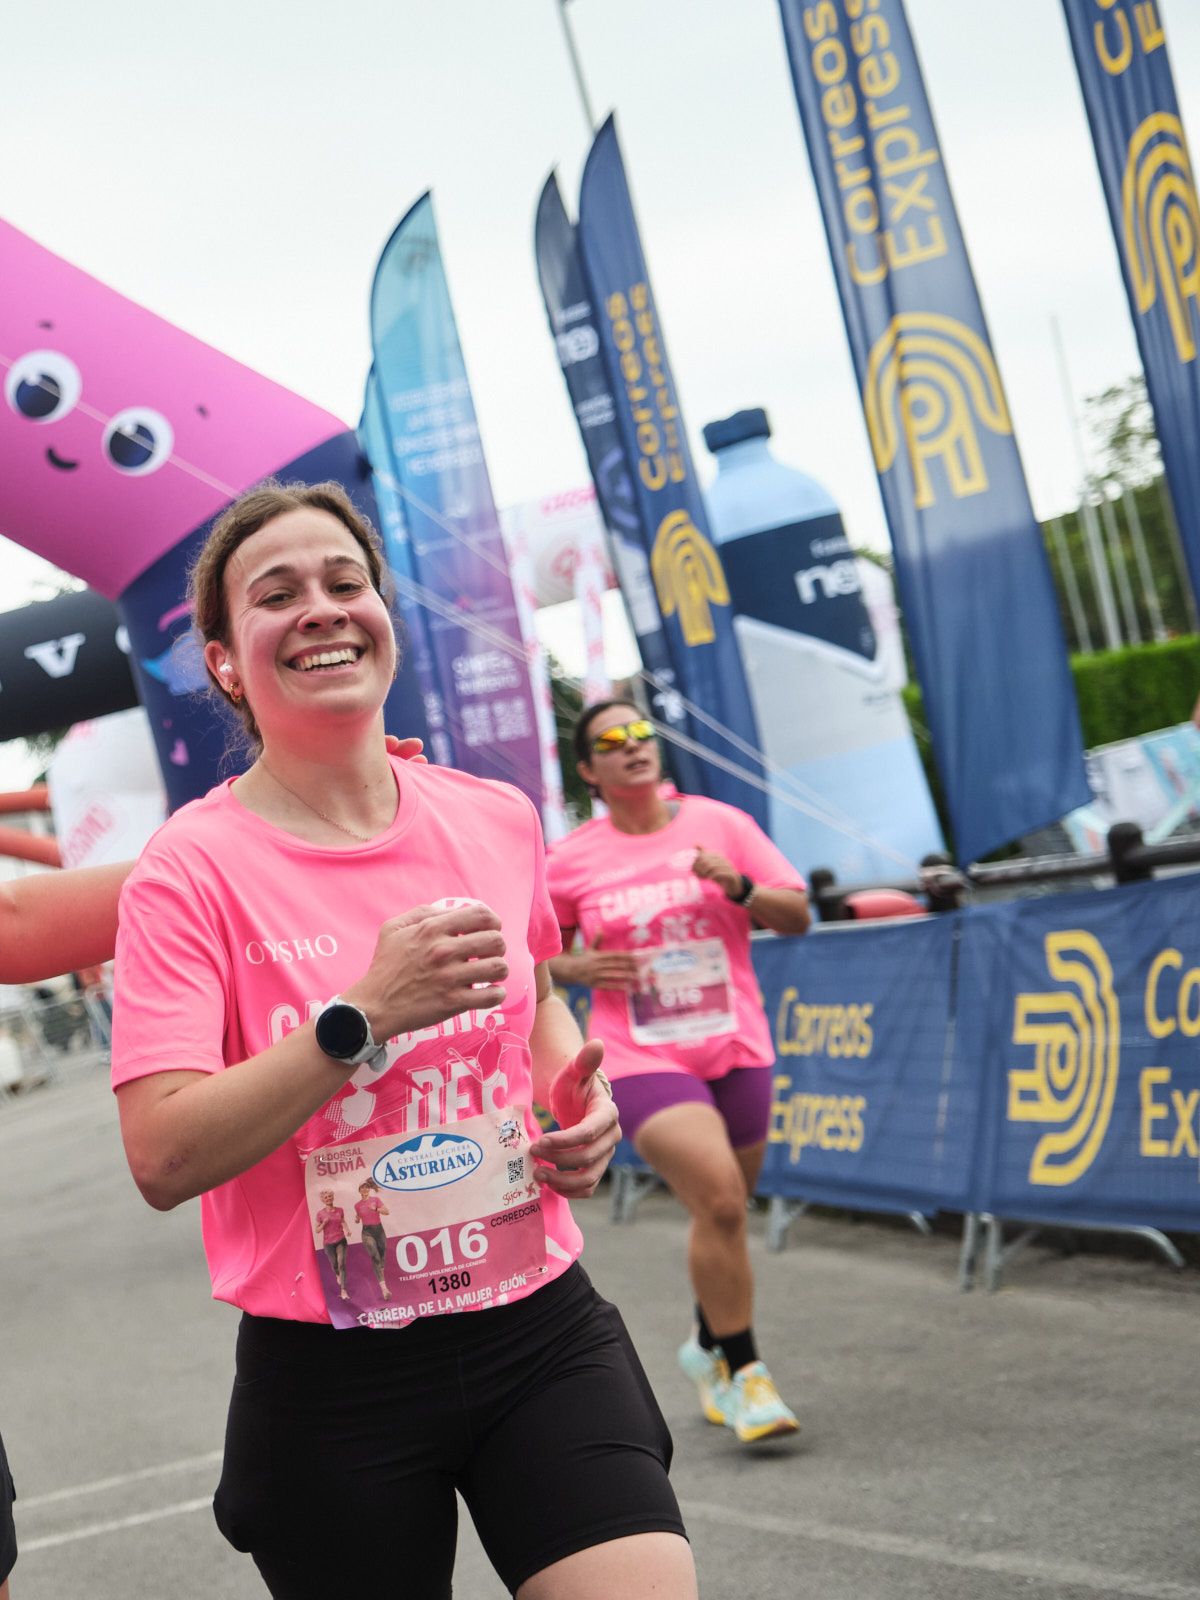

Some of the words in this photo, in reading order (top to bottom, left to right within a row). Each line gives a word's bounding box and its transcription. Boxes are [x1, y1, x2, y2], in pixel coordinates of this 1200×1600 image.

[245, 934, 338, 965] OYSHO
[1139, 1066, 1200, 1158] Ex
[316, 1155, 366, 1177] SUMA
[383, 1151, 477, 1184] ASTURIANA
[395, 1221, 489, 1274] 016
[428, 1271, 471, 1294] 1380
[358, 1305, 416, 1326] CARRERA
[418, 1301, 436, 1315] DE
[437, 1297, 454, 1312] LA
[455, 1286, 493, 1307] MUJER
[499, 1273, 527, 1294] GIJÓN
